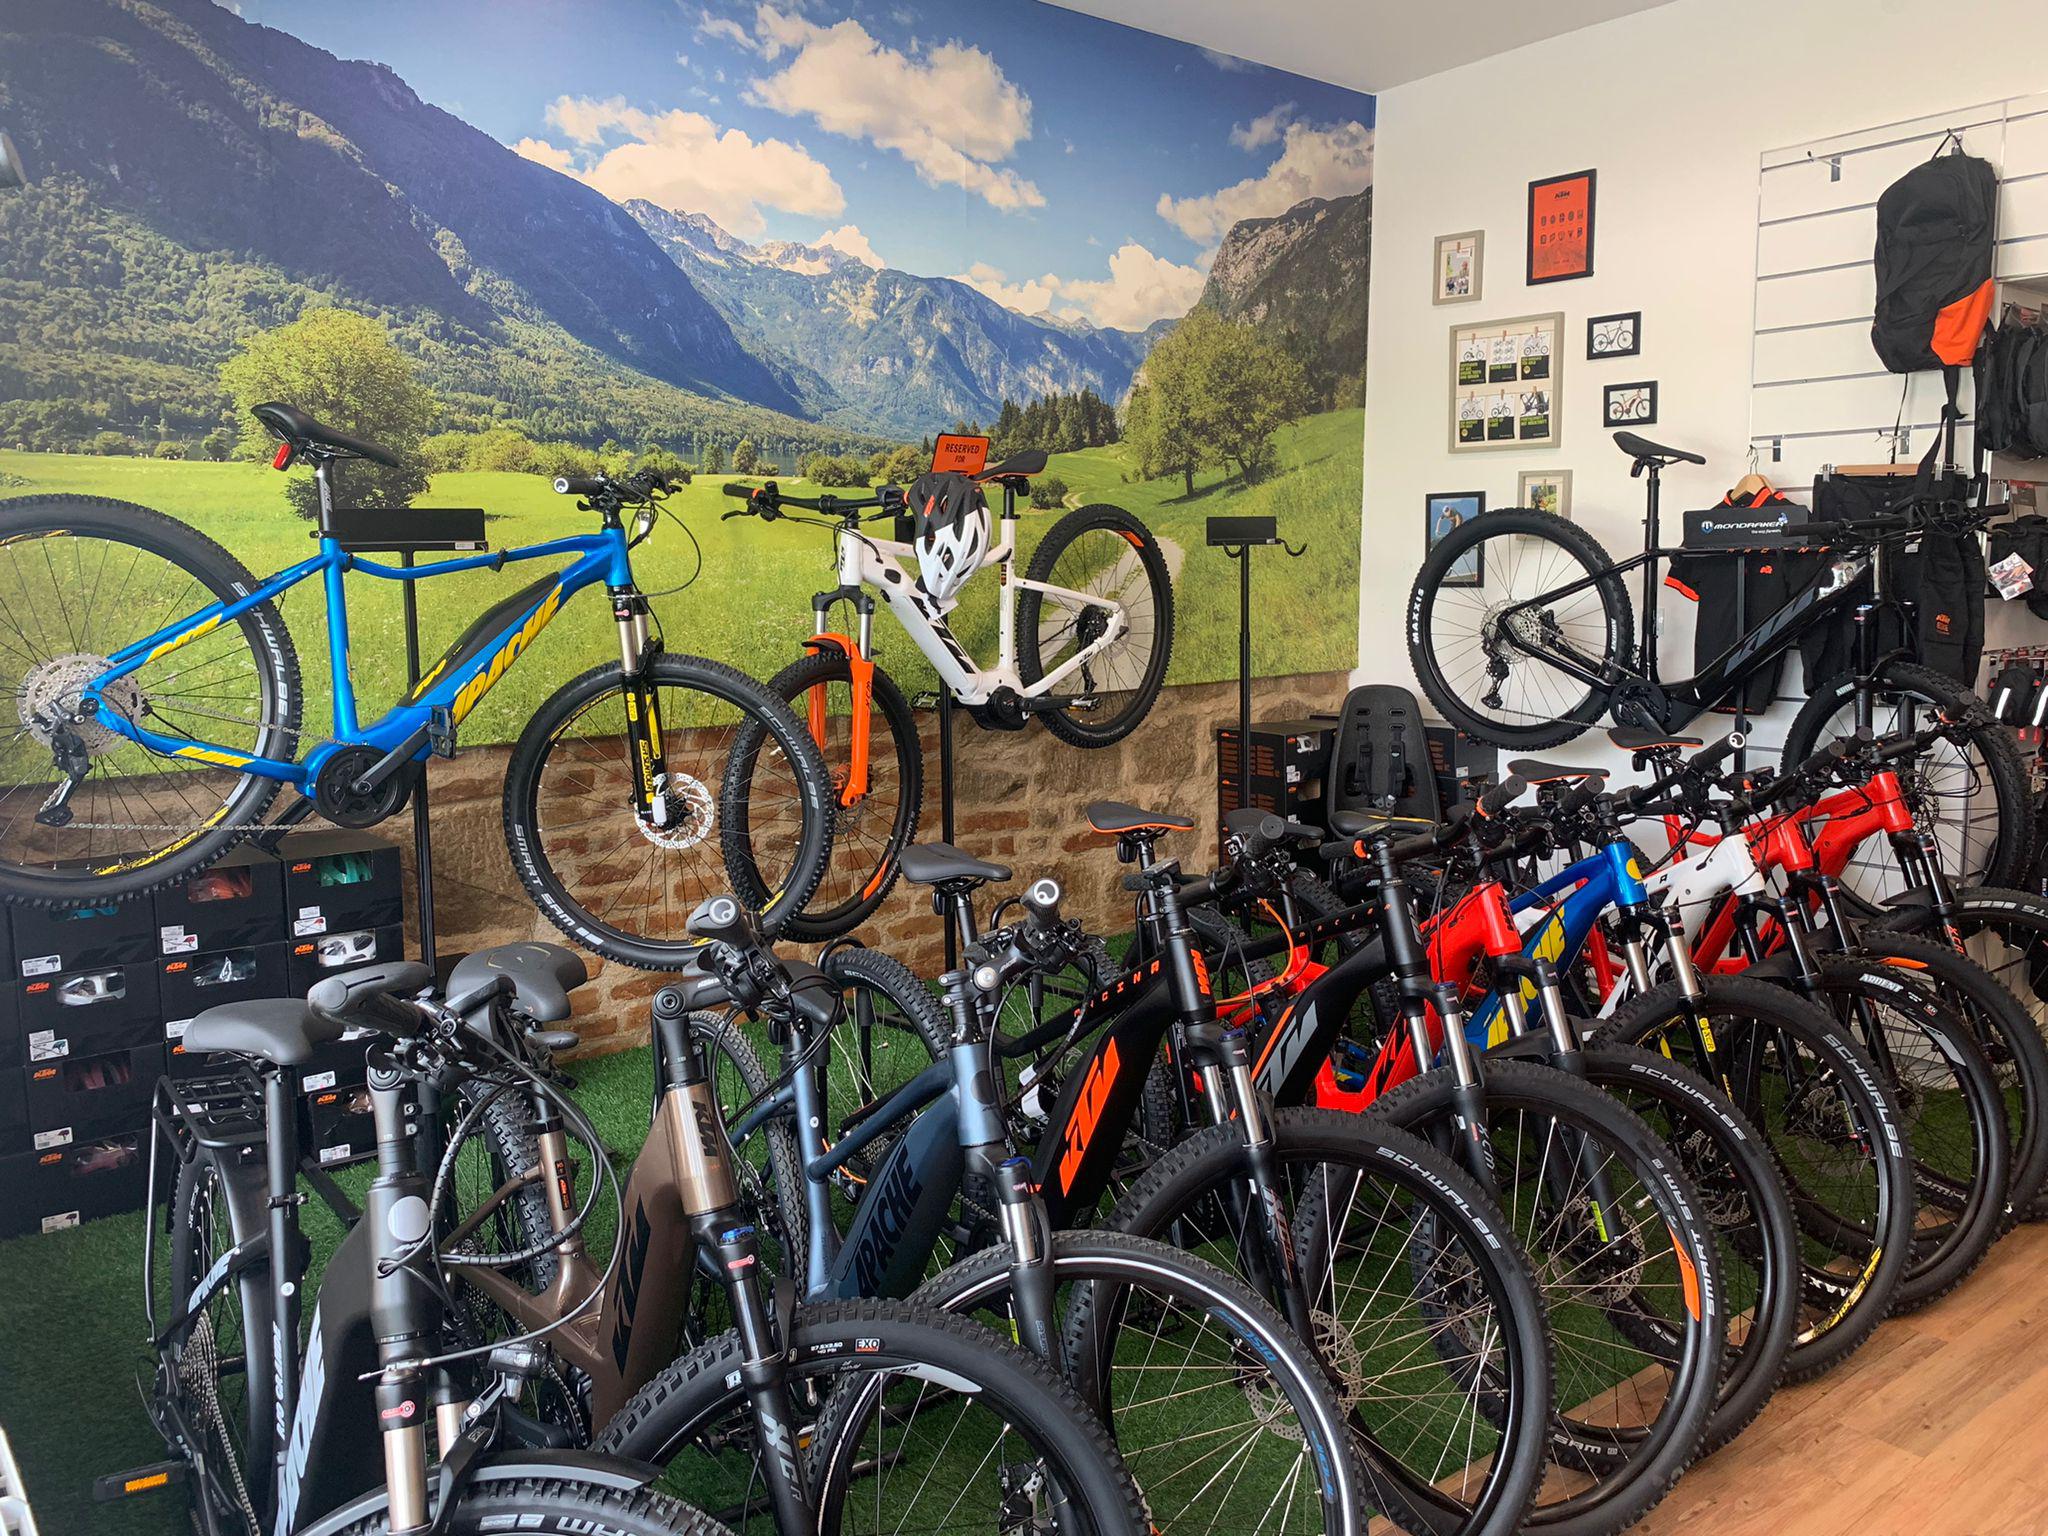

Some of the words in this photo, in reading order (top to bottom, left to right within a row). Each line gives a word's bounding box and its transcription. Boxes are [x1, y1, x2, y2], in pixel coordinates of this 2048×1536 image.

[944, 443, 980, 454] RESERVED
[954, 455, 966, 463] FOR
[1713, 520, 1784, 530] MONDRAKER
[231, 581, 288, 716] SHWALBE
[452, 582, 563, 726] APACHE
[1412, 587, 1425, 646] MAXXIS
[758, 705, 819, 810] SCHWALBE
[514, 823, 543, 887] SMART
[541, 892, 576, 928] SAM
[1859, 973, 1904, 993] ARDENT
[1059, 1036, 1120, 1197] KTM
[1629, 1063, 1747, 1141] SCHWALBE
[1822, 1033, 1903, 1158] SCHWALBE
[1376, 1146, 1501, 1250] SCHWALBE
[1663, 1173, 1694, 1221] SAM
[1690, 1229, 1715, 1316] SMART
[857, 1339, 879, 1349] EXO
